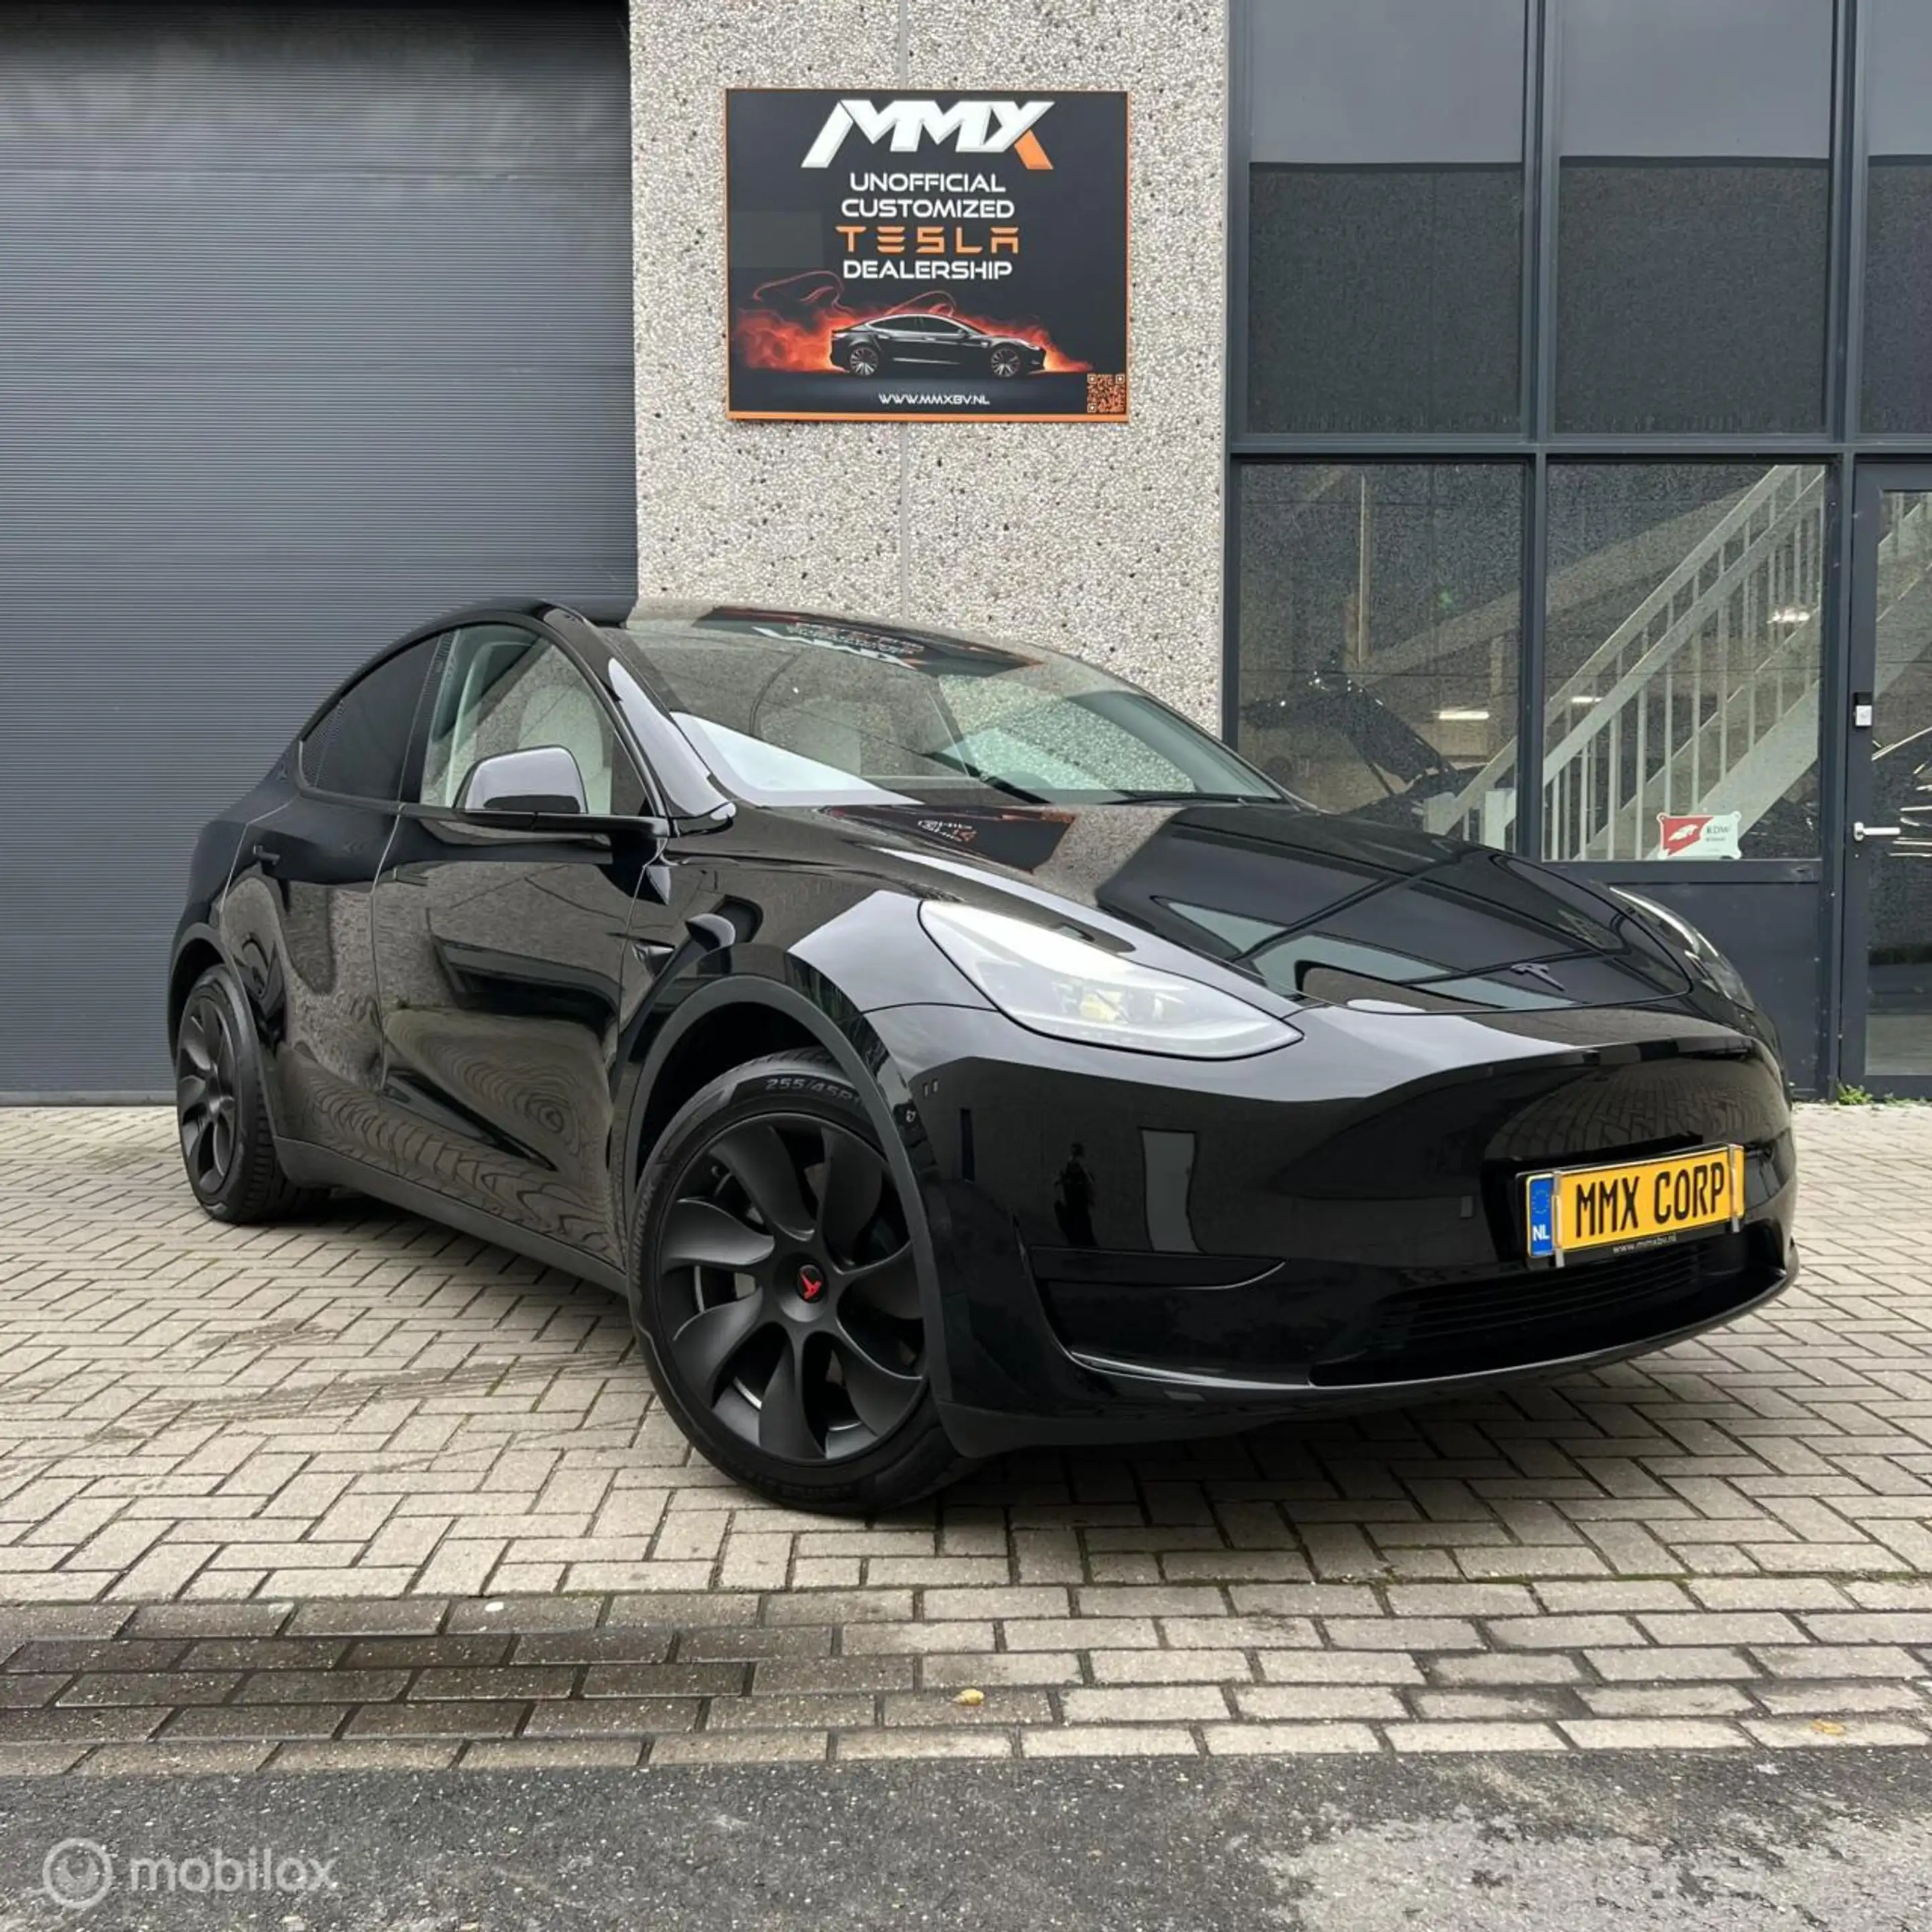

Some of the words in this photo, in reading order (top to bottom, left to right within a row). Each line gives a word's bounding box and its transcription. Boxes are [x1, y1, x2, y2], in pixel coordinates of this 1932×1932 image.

[801, 99, 1055, 170] MMX
[849, 172, 1007, 193] UNOFFICIAL
[841, 199, 1015, 219] CUSTOMIZED
[836, 226, 1018, 254] TESLA
[843, 260, 1012, 280] DEALERSHIP
[878, 394, 990, 405] WWW.MMXBV.NL
[1576, 1175, 1640, 1238] MMX
[1654, 1161, 1725, 1225] CORP
[1532, 1224, 1550, 1241] NL
